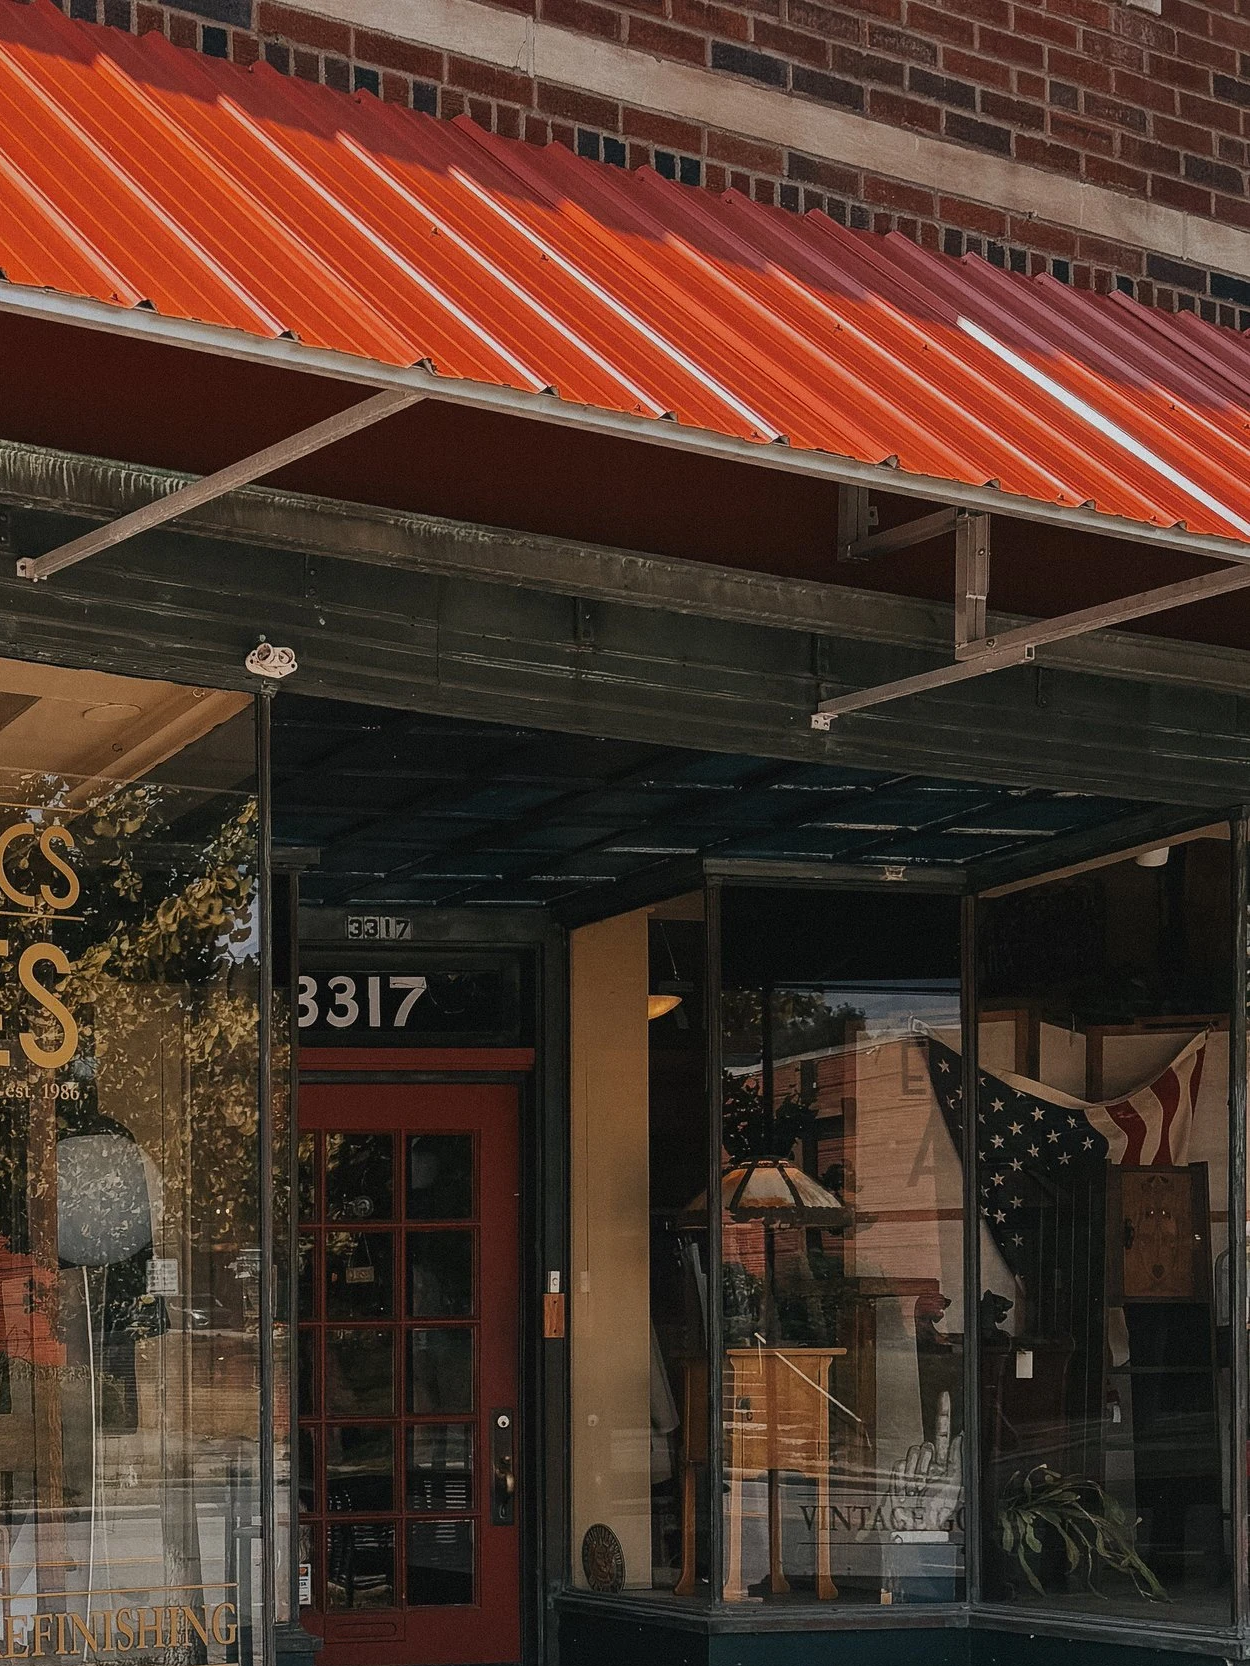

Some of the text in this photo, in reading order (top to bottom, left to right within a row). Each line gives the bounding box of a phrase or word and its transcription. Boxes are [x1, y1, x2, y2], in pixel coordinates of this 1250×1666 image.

[349, 917, 411, 938] 3317
[298, 975, 427, 1028] 3317
[42, 1083, 80, 1100] 1986
[799, 1505, 927, 1531] VINTAGE
